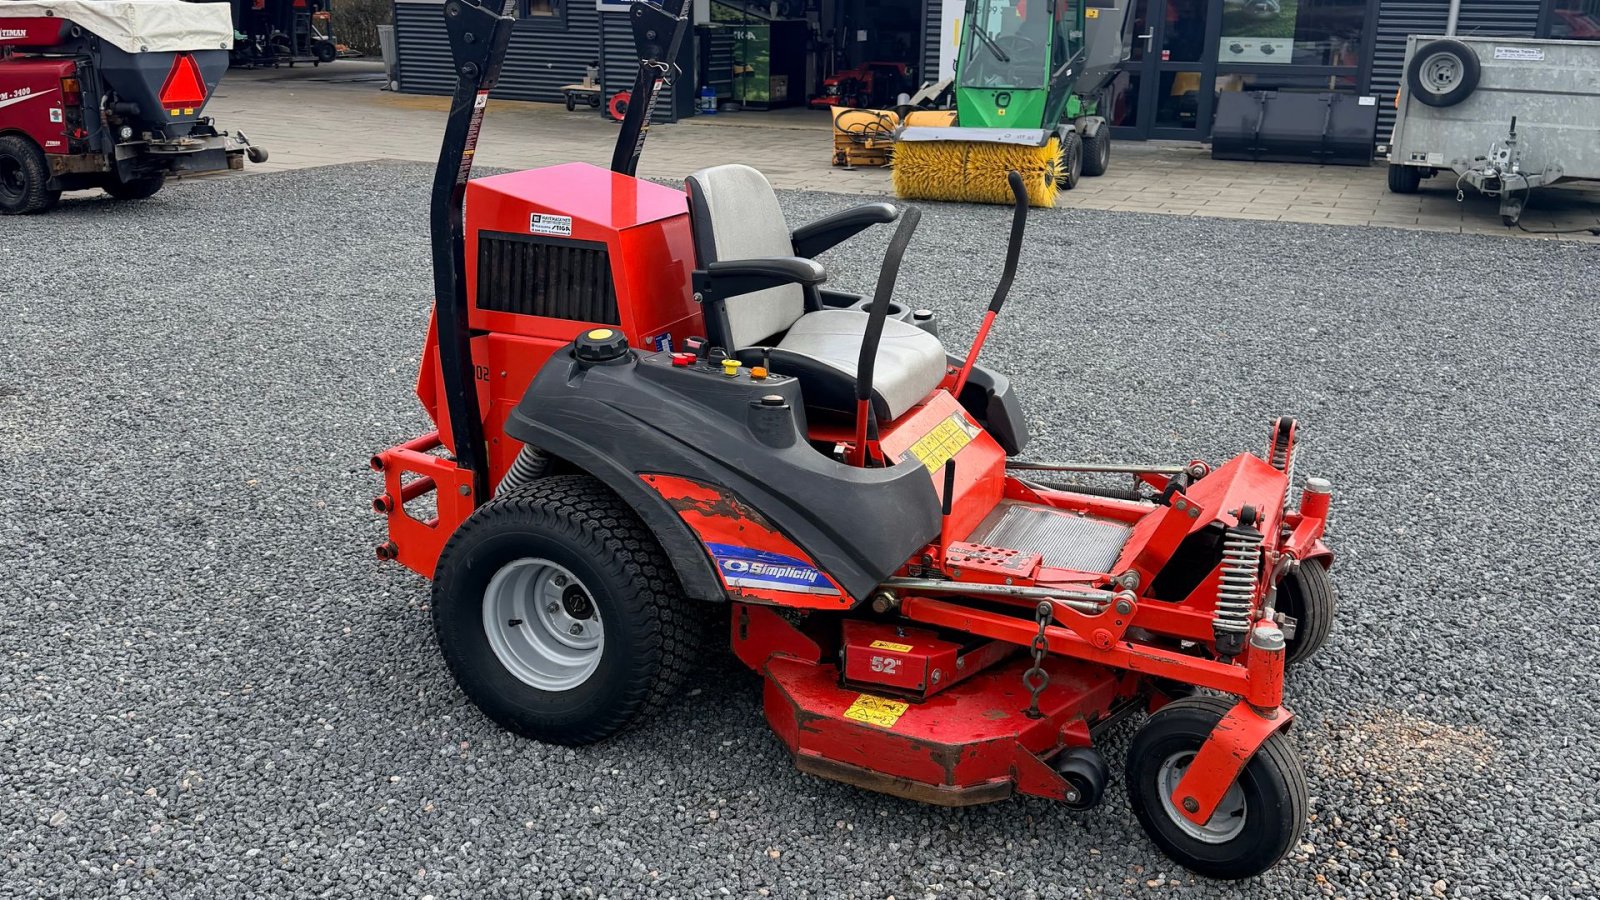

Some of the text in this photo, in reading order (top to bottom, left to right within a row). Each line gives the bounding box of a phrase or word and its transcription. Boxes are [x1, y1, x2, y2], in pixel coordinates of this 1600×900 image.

[0, 92, 8, 101] M
[13, 87, 31, 98] 3400
[749, 562, 818, 582] Simplicity
[871, 656, 902, 674] 52"
